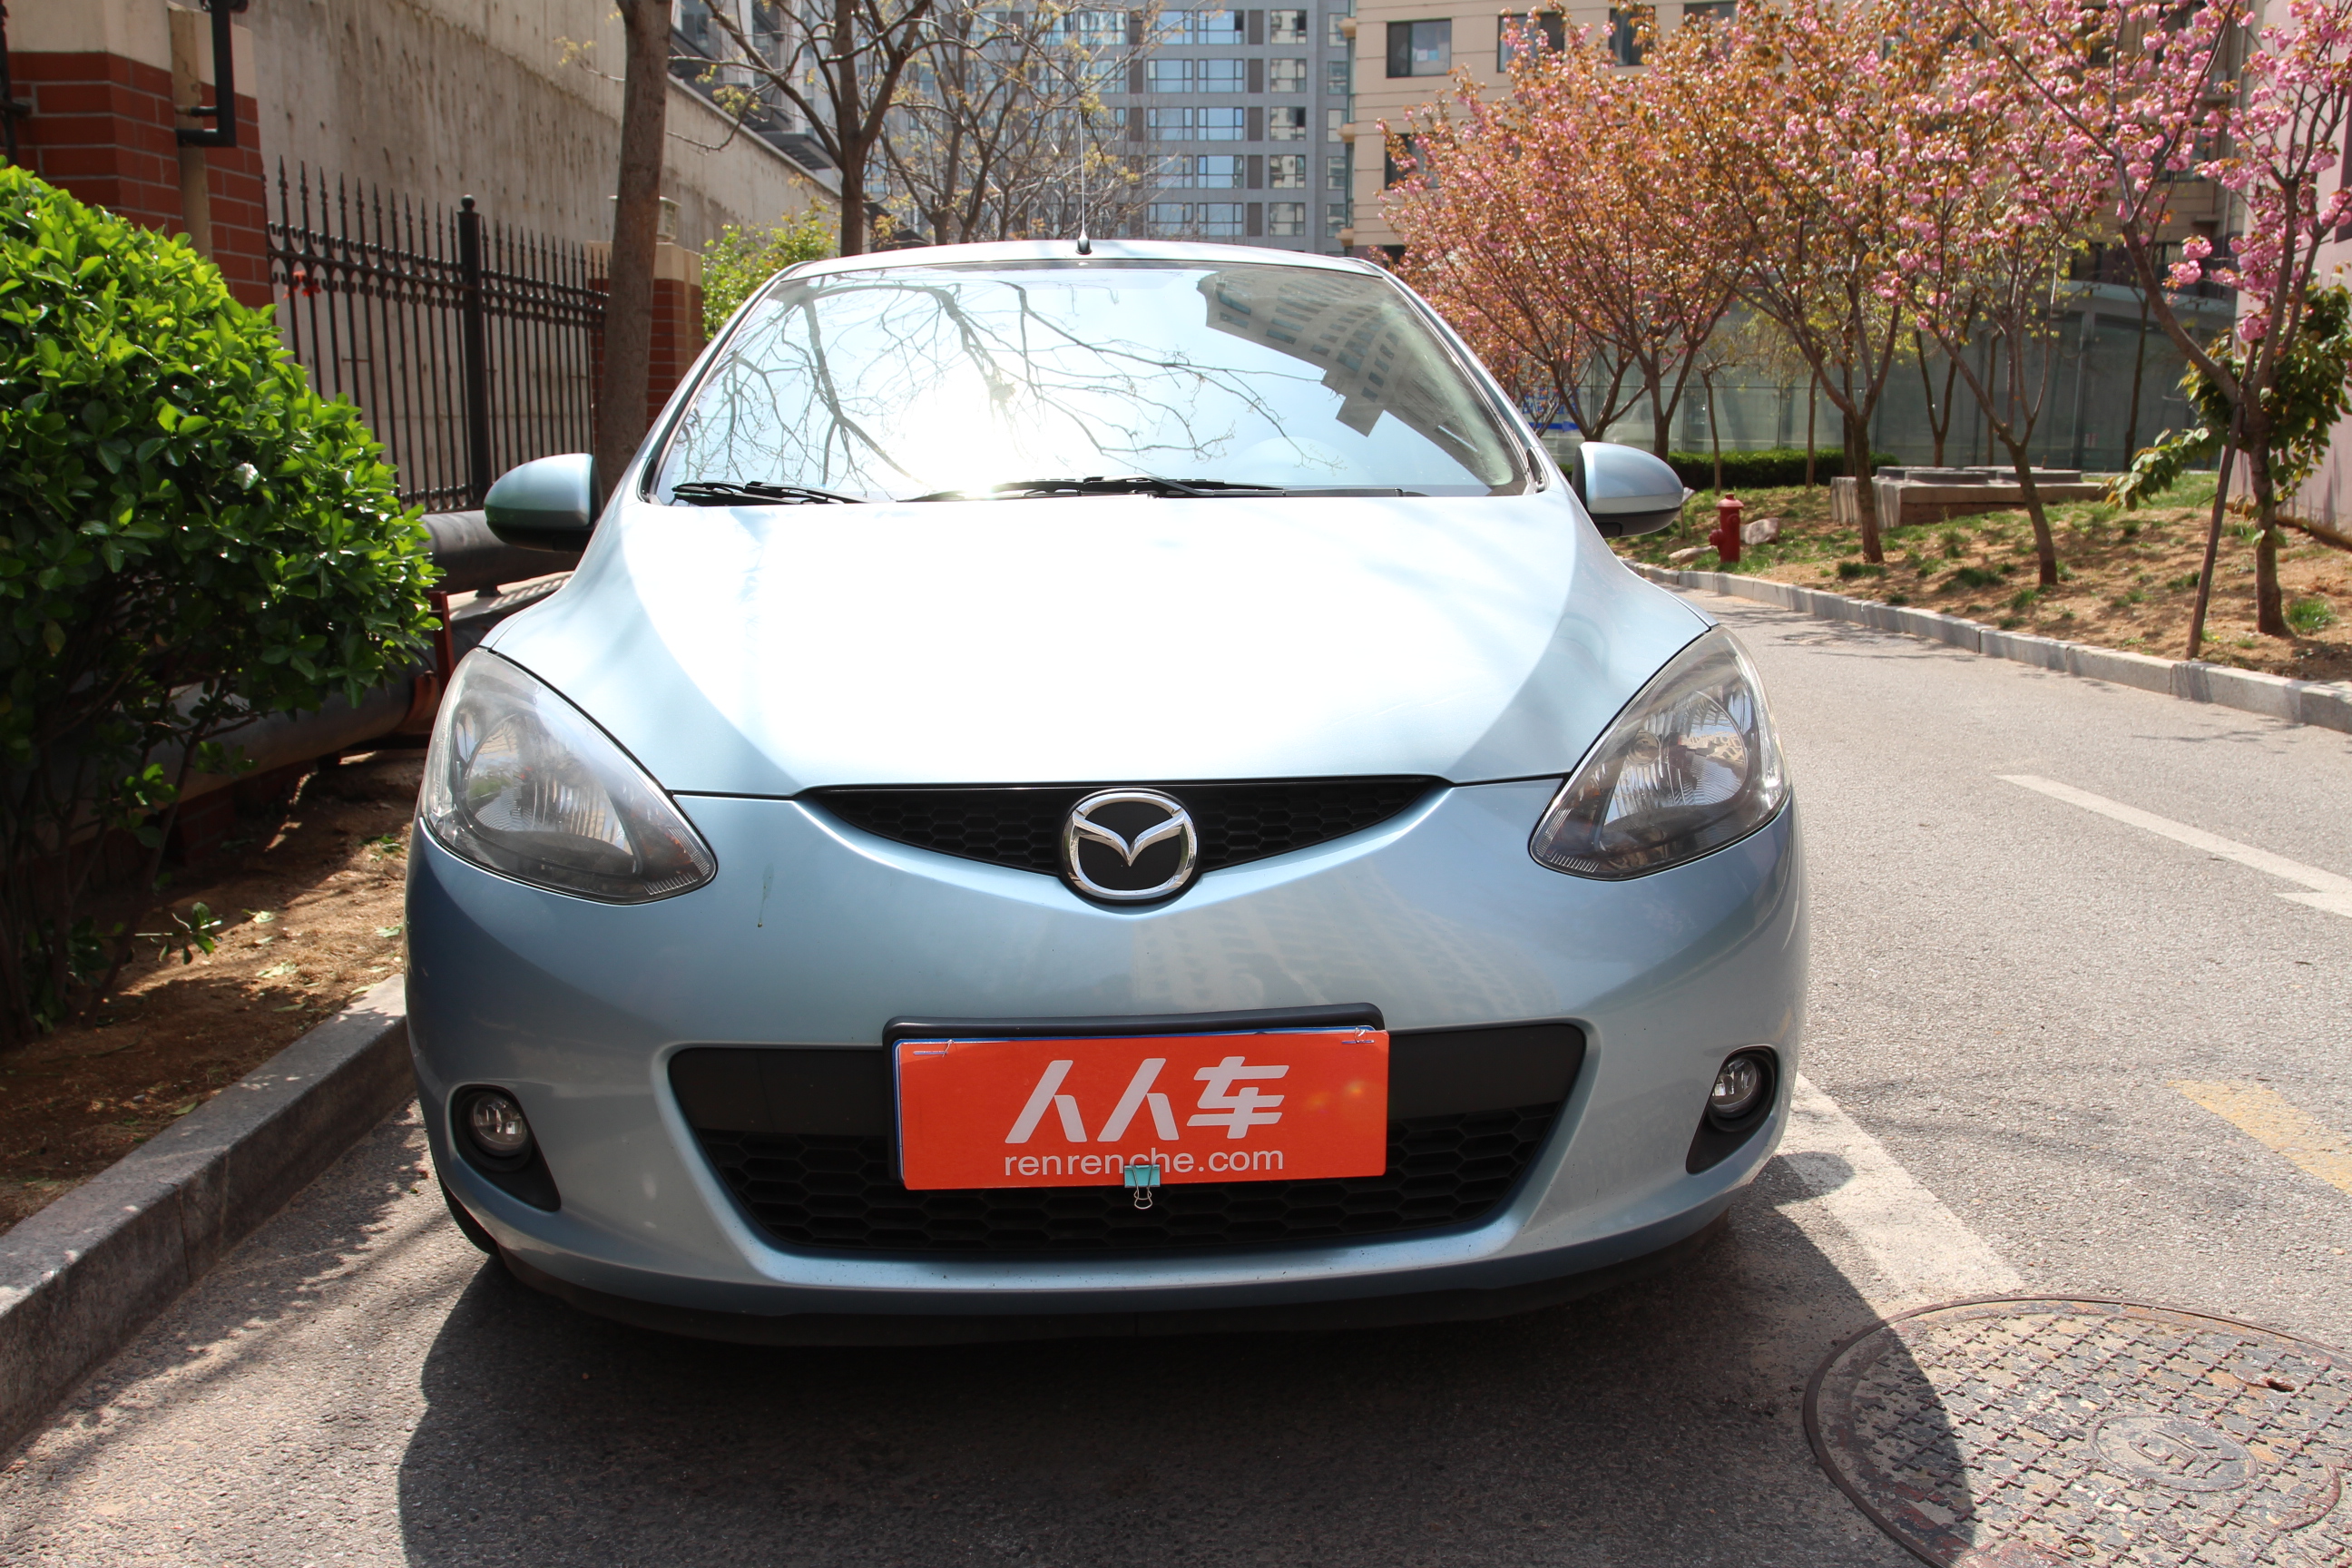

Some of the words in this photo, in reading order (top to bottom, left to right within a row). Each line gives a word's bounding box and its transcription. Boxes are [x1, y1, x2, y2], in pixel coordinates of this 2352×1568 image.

[1004, 1055, 1289, 1144] 人人车
[1004, 1147, 1284, 1176] renrenche.com
